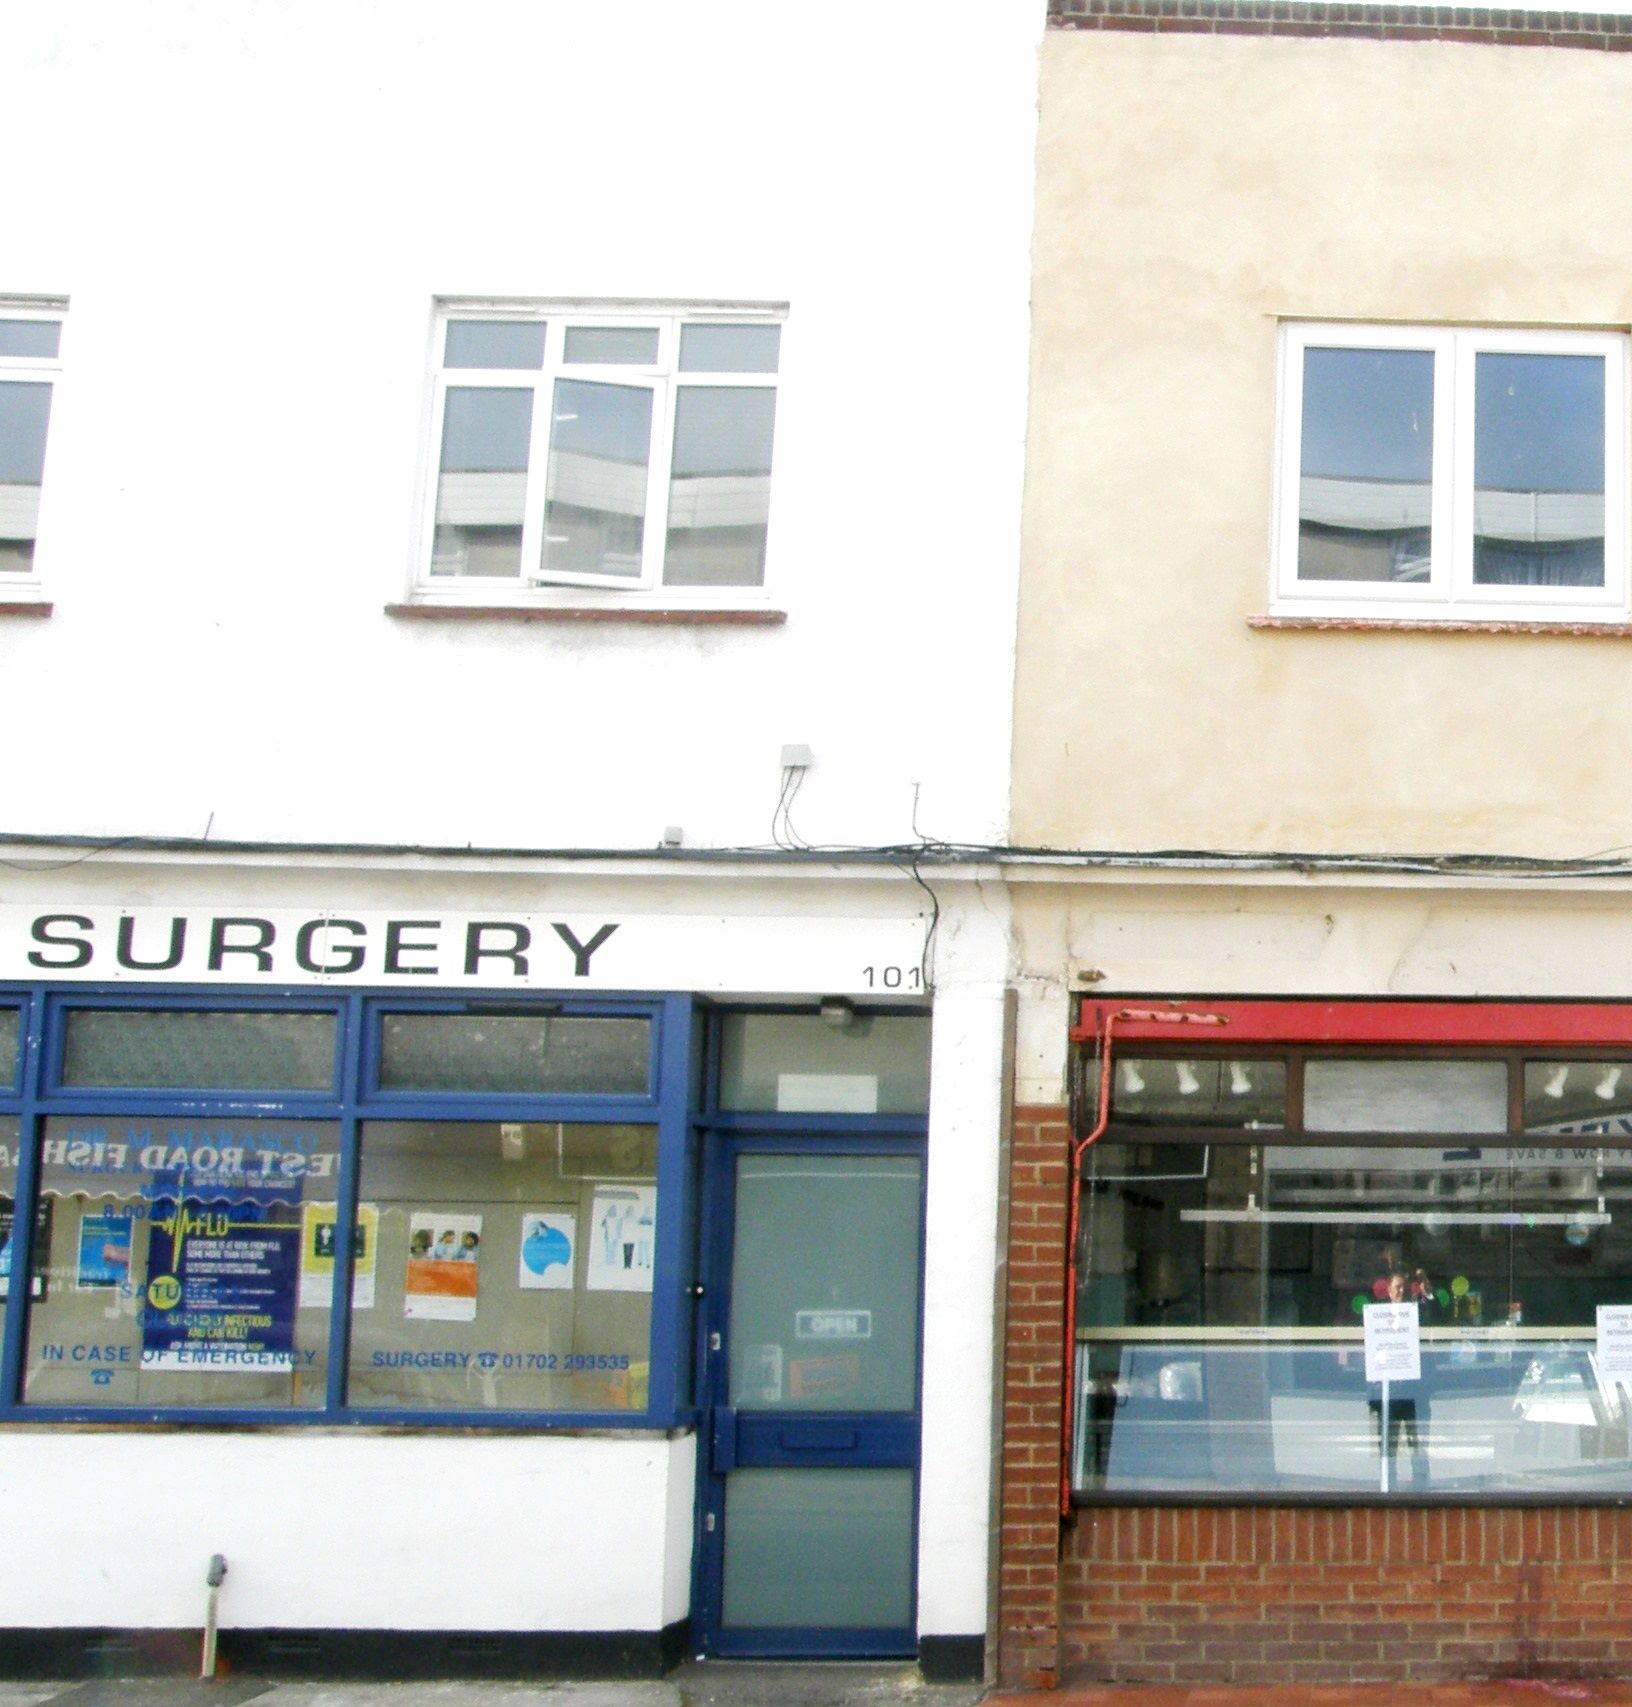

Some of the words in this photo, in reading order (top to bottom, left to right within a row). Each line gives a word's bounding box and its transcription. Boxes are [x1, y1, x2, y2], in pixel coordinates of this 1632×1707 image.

[27, 914, 621, 977] SURGERY
[862, 966, 920, 988] 101
[811, 1315, 857, 1332] OPEN
[42, 1344, 64, 1360] IN
[71, 1344, 131, 1362] CASE
[139, 1348, 166, 1365] OF
[178, 1349, 316, 1367] EMERGENCY
[371, 1350, 471, 1368] SURGERY
[503, 1353, 557, 1369] 01702
[563, 1352, 630, 1370] 293535
